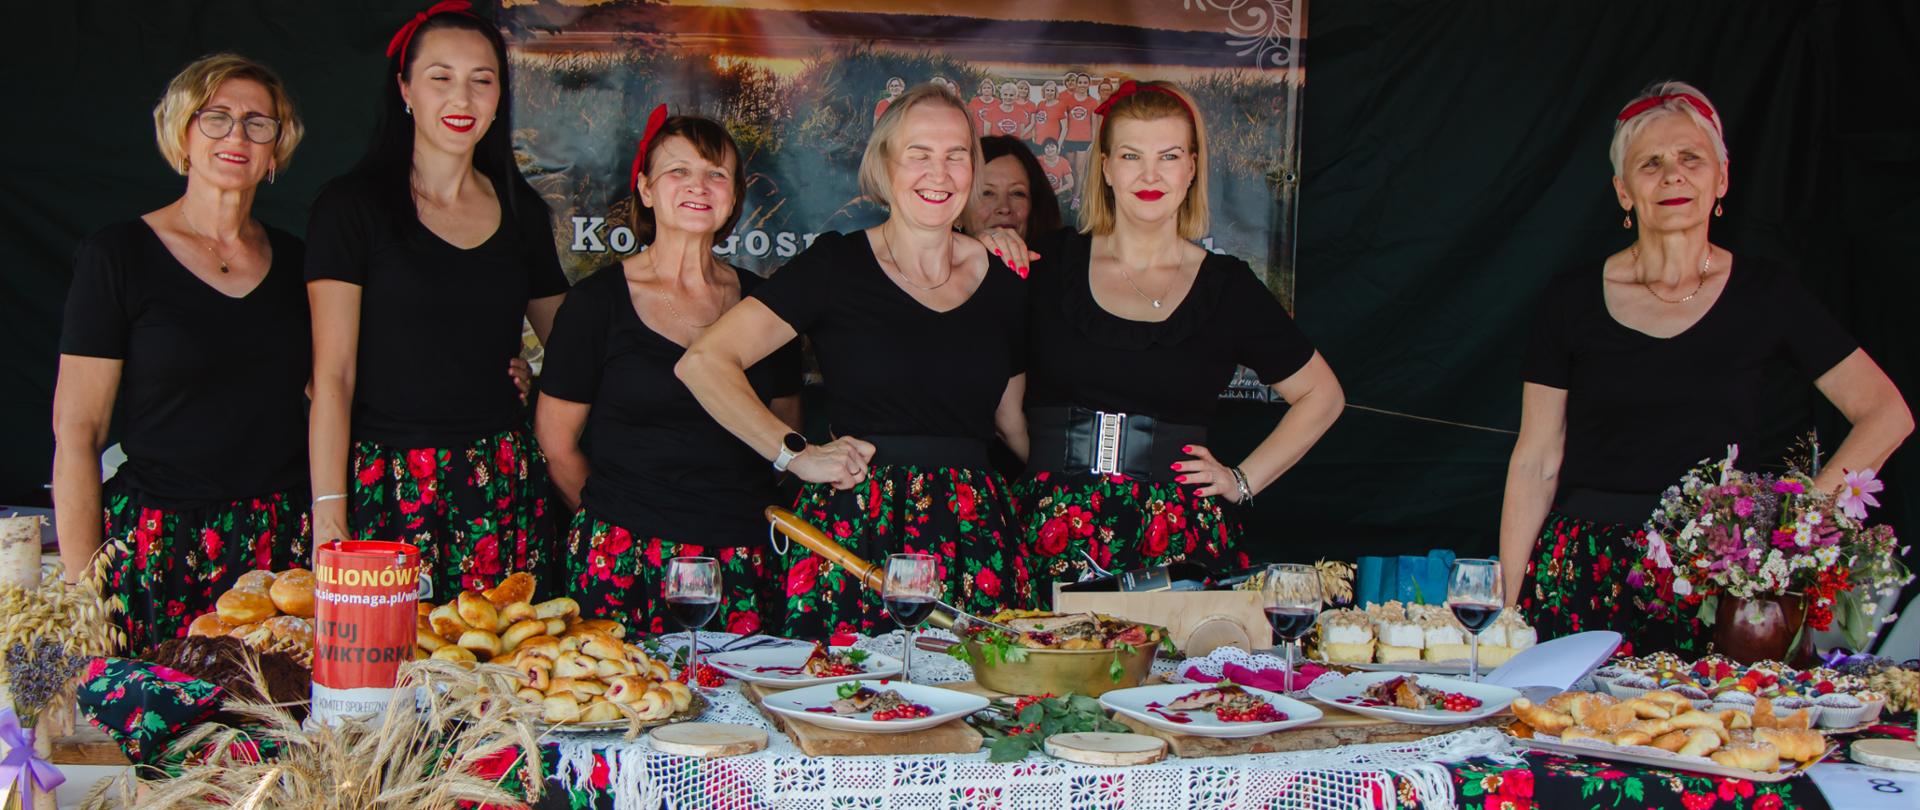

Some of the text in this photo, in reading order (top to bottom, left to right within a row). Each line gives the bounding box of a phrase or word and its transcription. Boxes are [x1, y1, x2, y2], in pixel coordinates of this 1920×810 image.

[571, 216, 648, 253] Ko
[317, 564, 412, 587] MILIONÓW
[320, 642, 413, 664] WIKTORKA
[1868, 778, 1903, 793] 8
